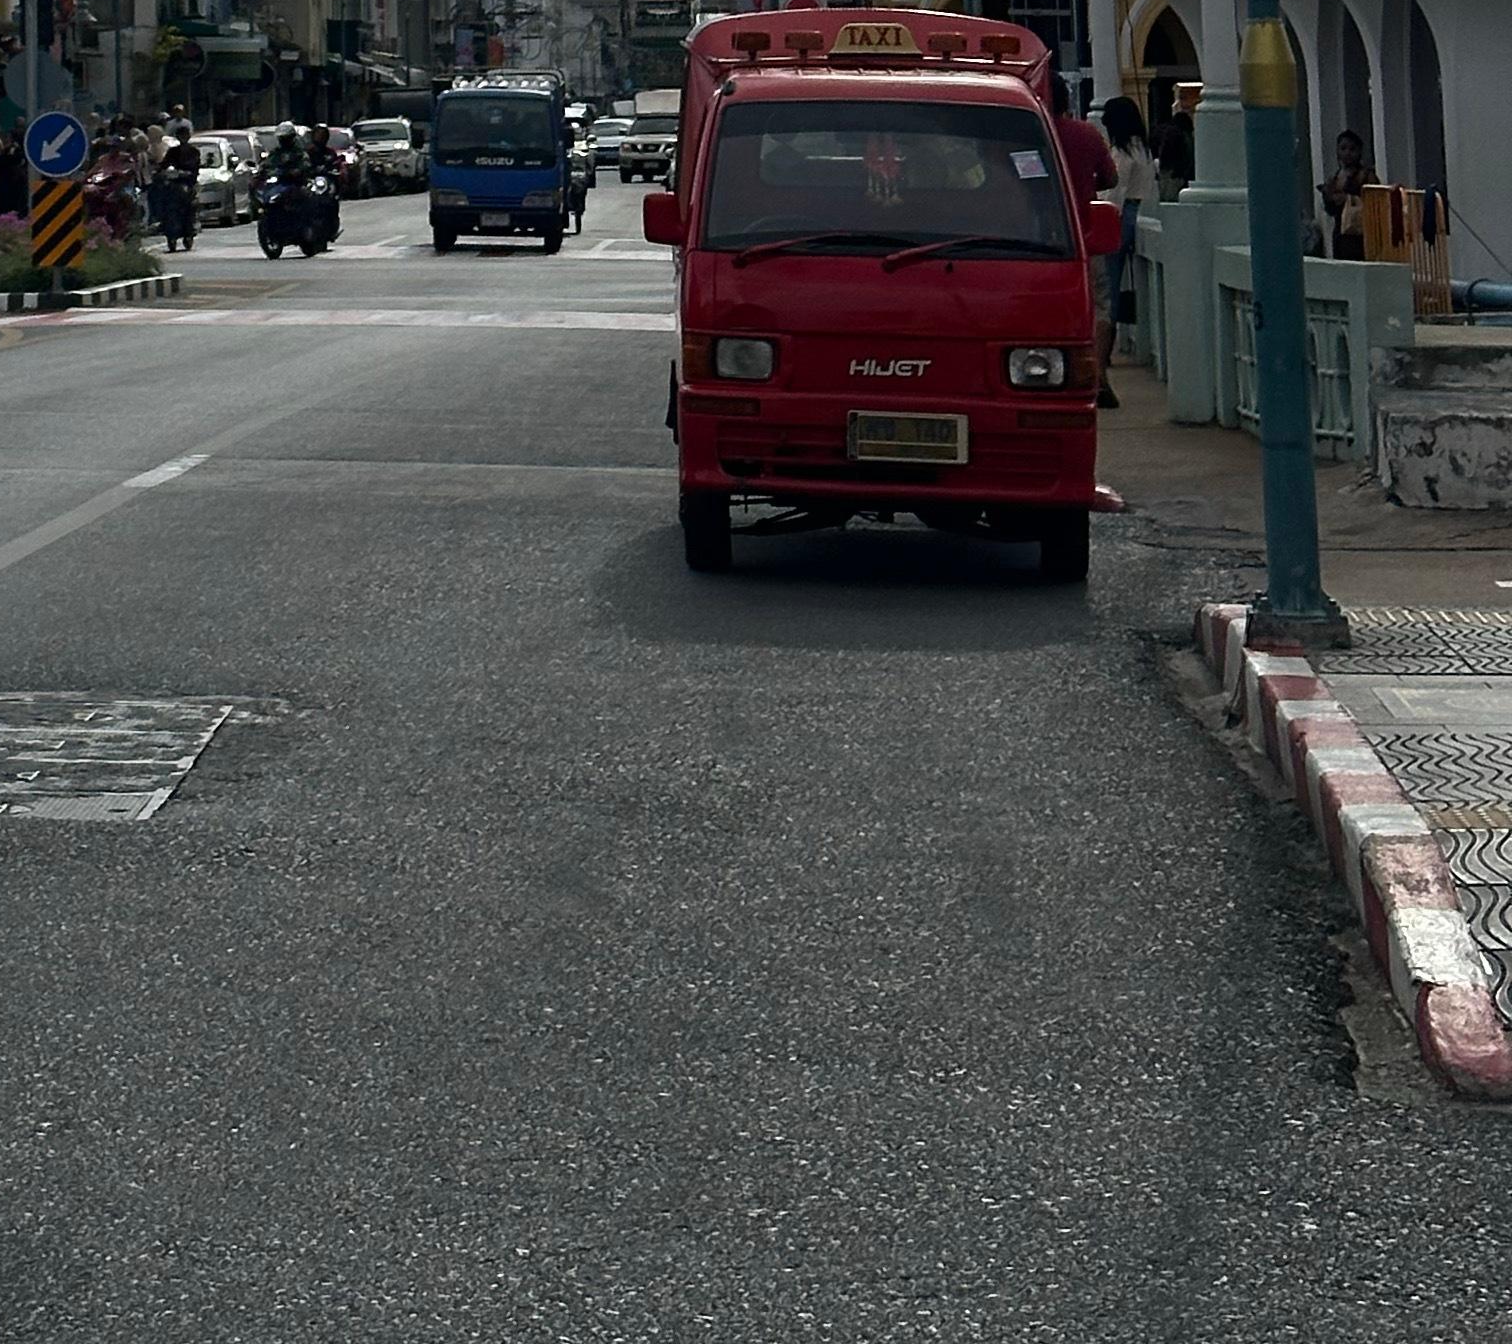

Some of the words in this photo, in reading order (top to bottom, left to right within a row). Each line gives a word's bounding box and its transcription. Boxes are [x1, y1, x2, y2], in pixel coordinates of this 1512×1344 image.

[844, 26, 902, 46] TAXI
[475, 157, 515, 166] ISUZU
[849, 359, 932, 376] HIJET
